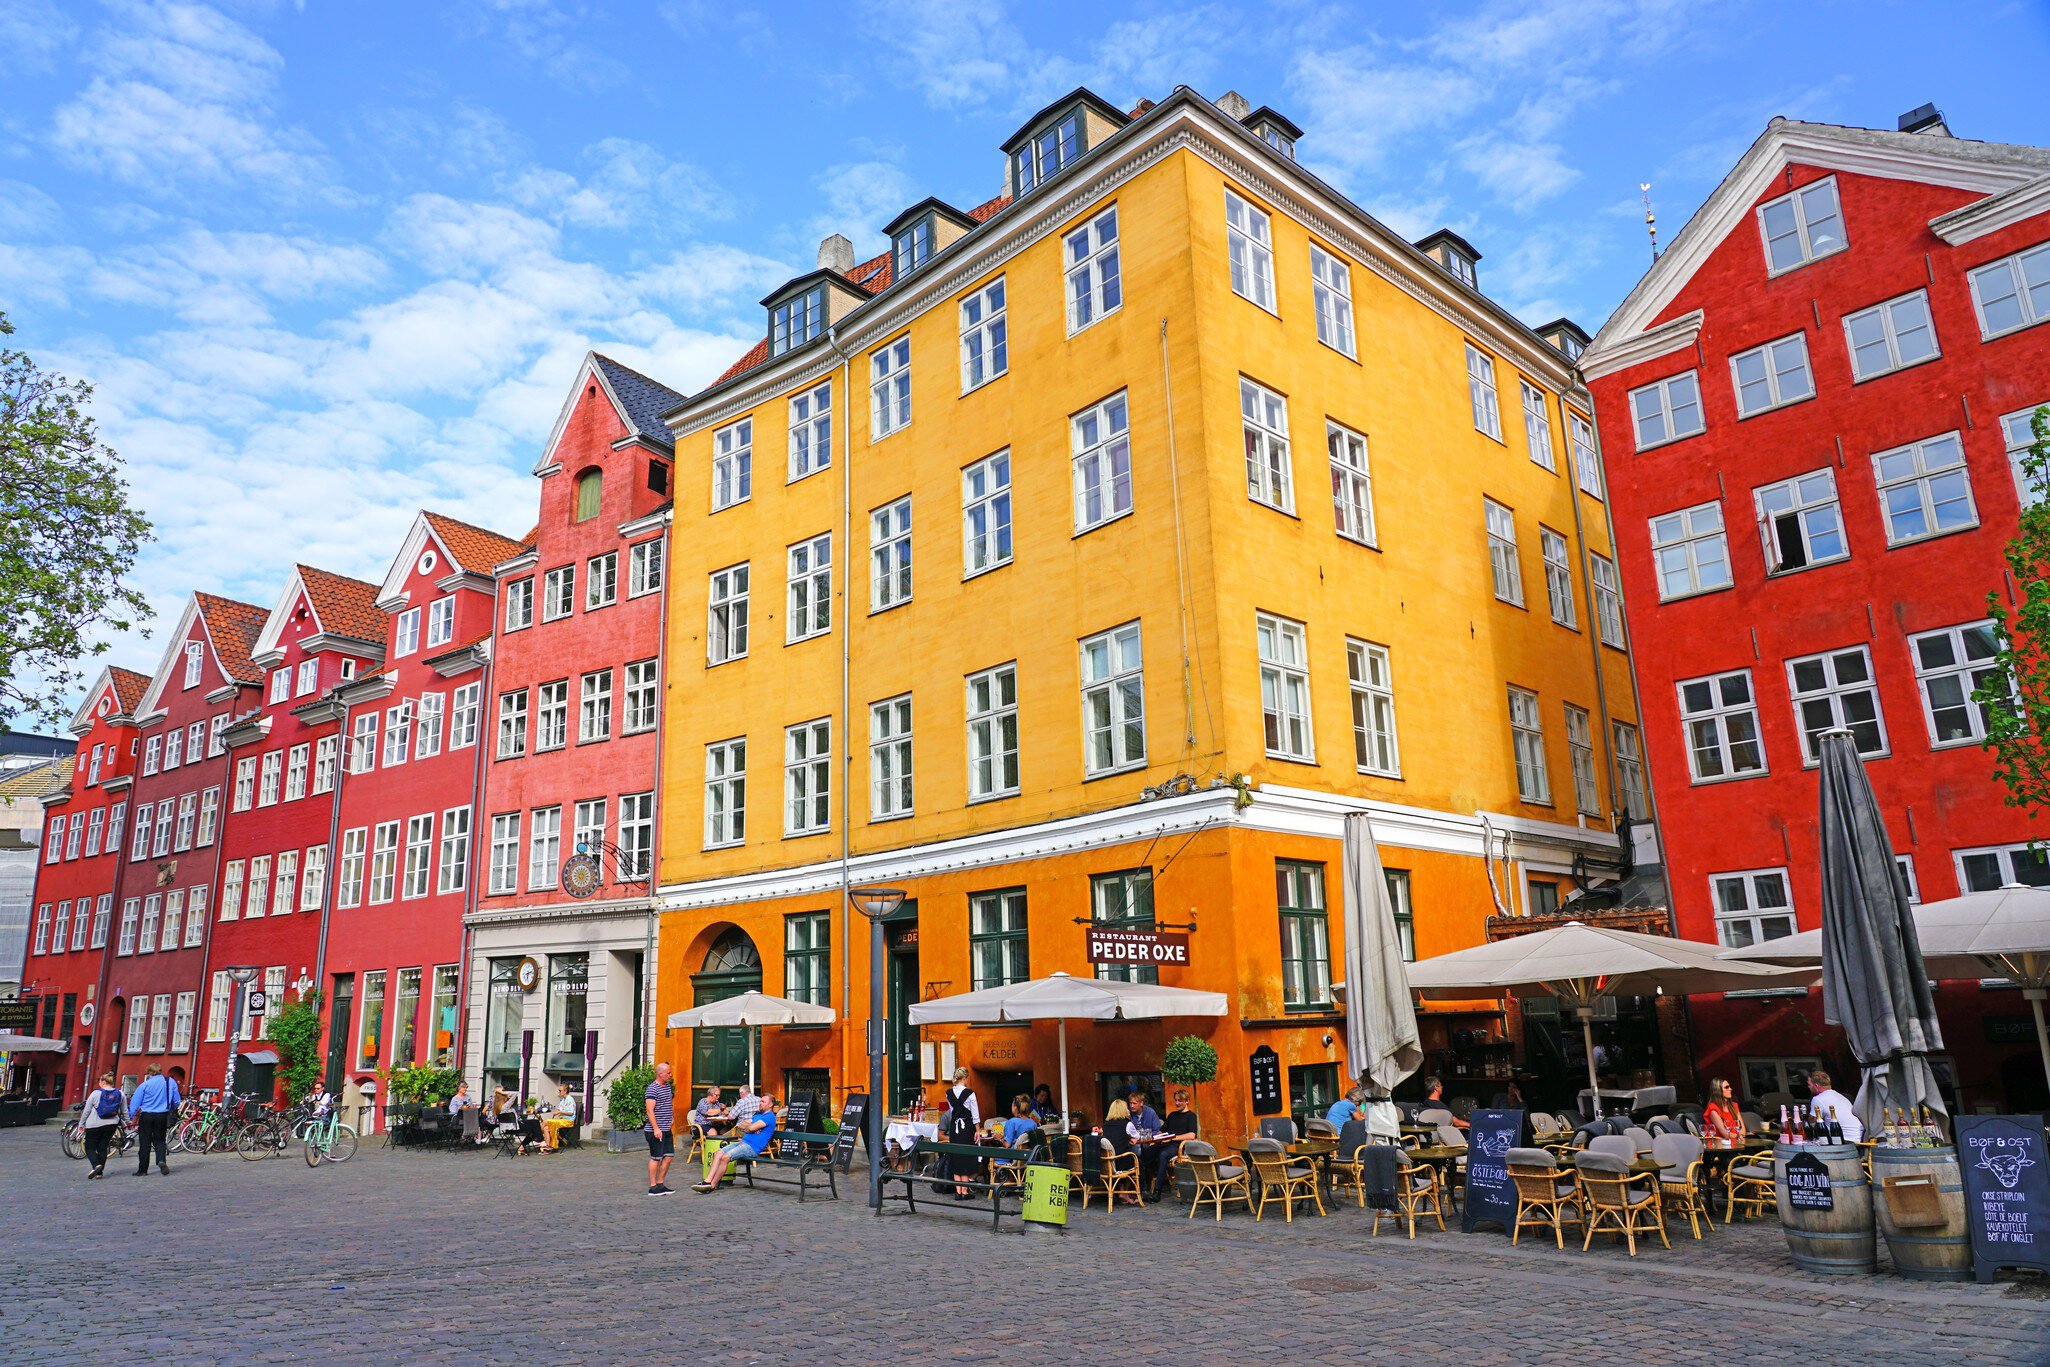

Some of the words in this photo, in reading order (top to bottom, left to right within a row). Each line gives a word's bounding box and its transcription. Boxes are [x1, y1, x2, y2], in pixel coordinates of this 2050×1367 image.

[1092, 932, 1157, 942] RESTAURANT
[1092, 941, 1149, 960] PEDER
[1152, 944, 1186, 961] OXE
[983, 1049, 1017, 1059] KÆLDER
[1968, 1137, 1995, 1147] BØF
[1996, 1137, 2006, 1147] &
[2007, 1137, 2032, 1147] OST
[1050, 1184, 1069, 1196] REN
[1986, 1222, 2028, 1233] KALVEKOTELET
[2001, 1232, 2010, 1242] AF
[2010, 1232, 2034, 1244] ONGLET
